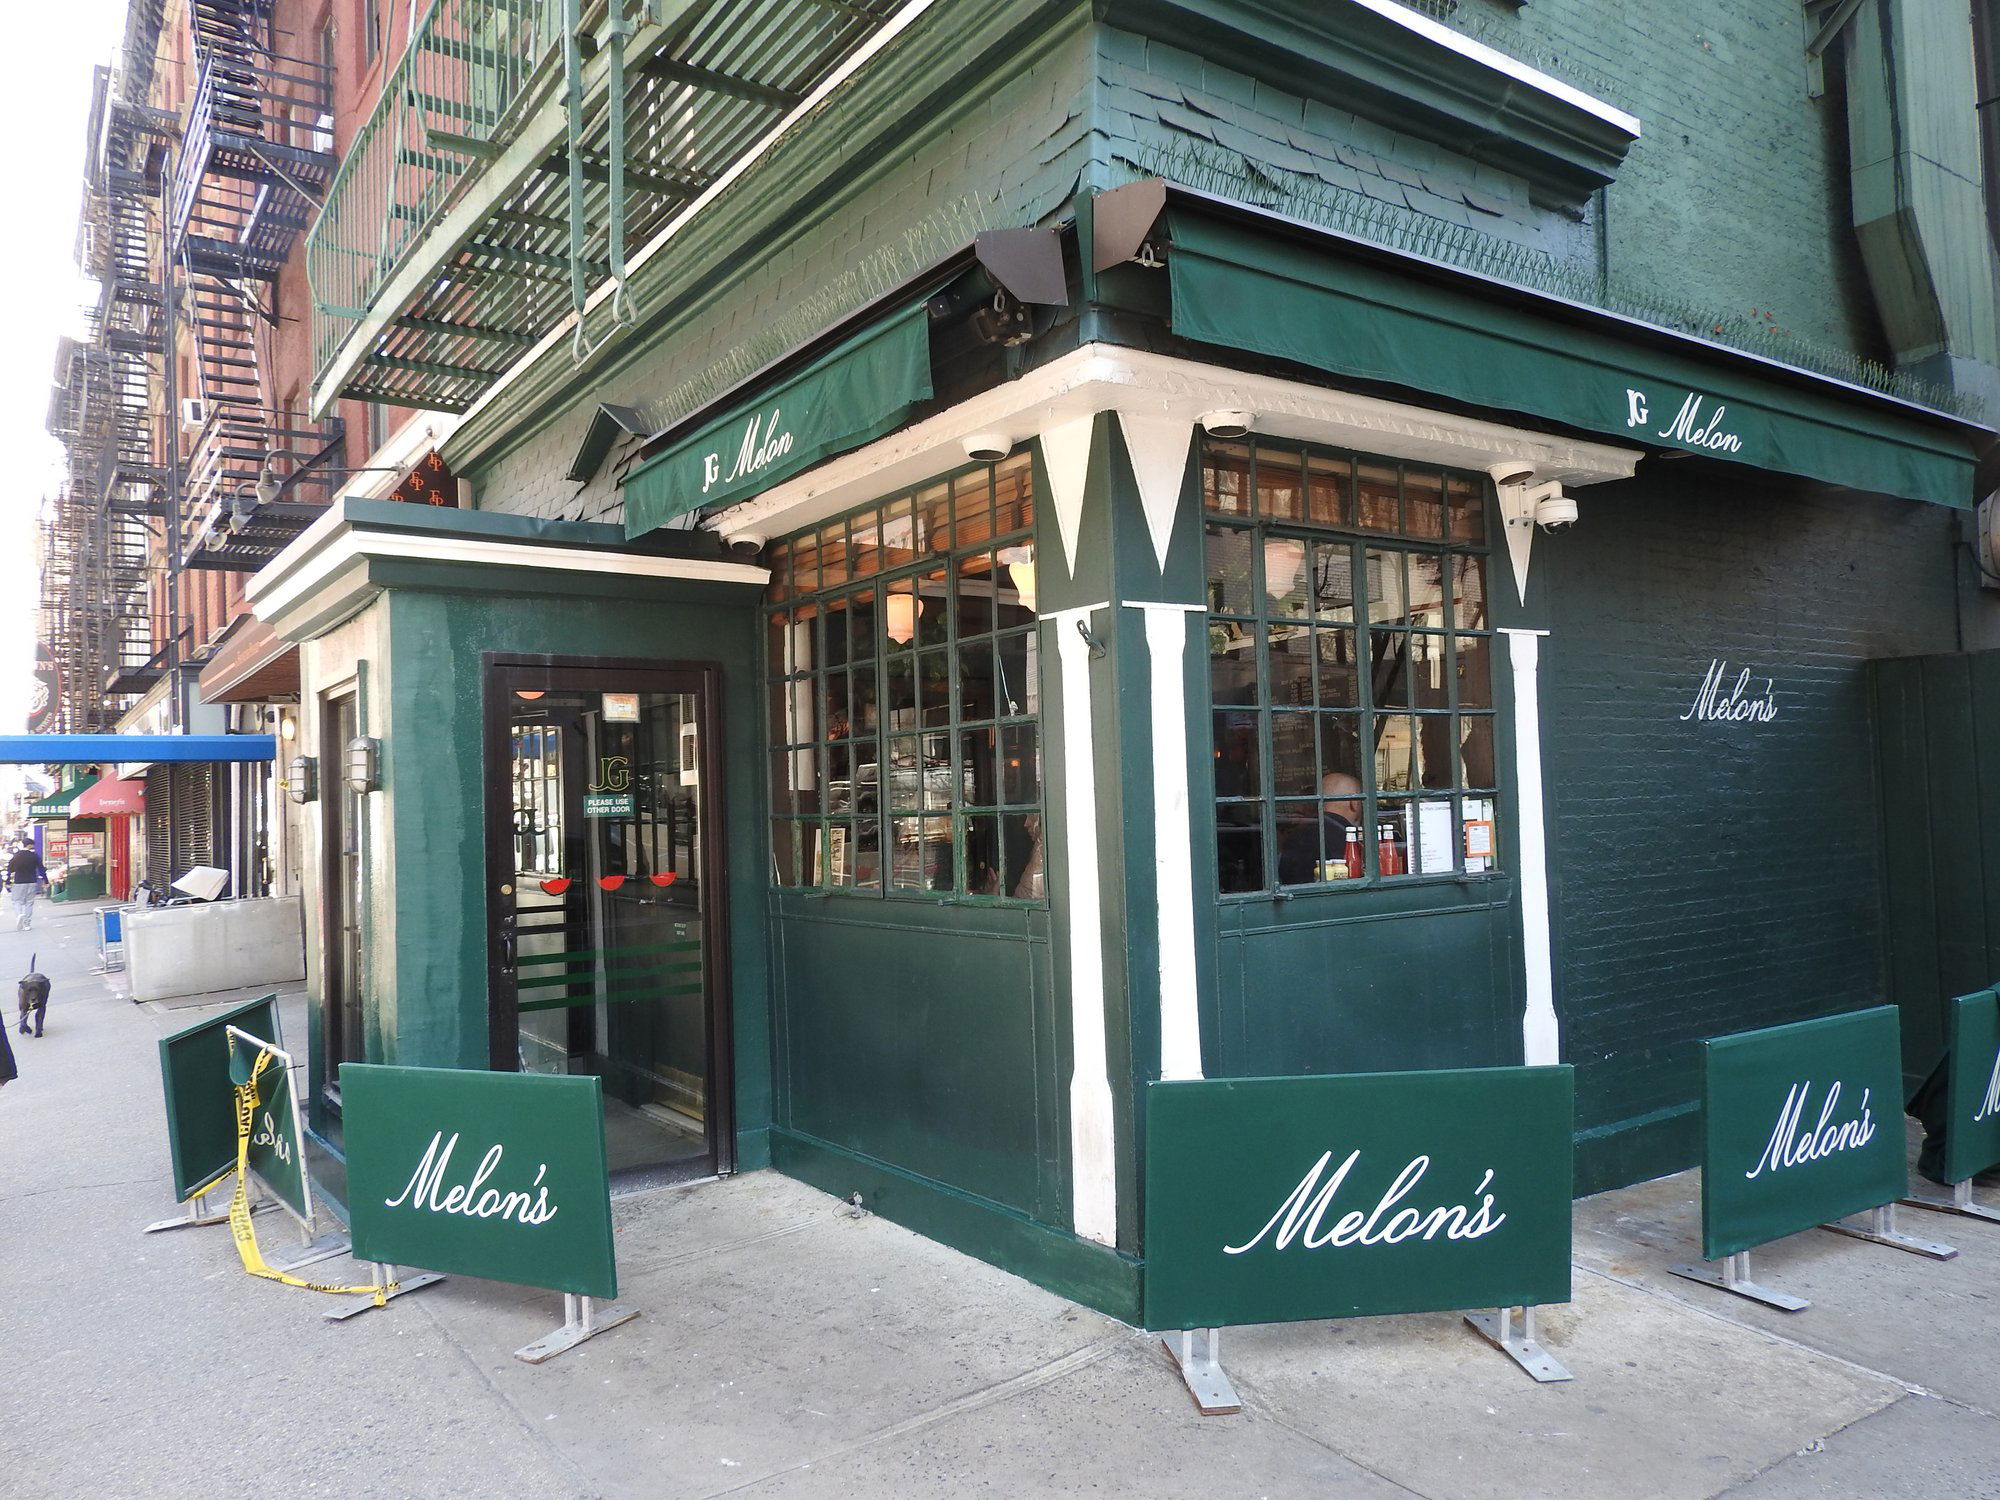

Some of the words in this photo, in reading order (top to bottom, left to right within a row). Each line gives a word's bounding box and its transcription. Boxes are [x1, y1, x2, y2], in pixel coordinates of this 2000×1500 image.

[725, 408, 793, 483] Melon
[1658, 391, 1743, 453] Melon
[1680, 658, 1778, 722] Melon's
[587, 806, 610, 814] OTHER
[588, 798, 613, 806] PLEASE
[71, 837, 93, 845] ATM
[1746, 1080, 1876, 1178] Melon's
[385, 1130, 558, 1224] Melon's
[1223, 1149, 1507, 1254] Melon's
